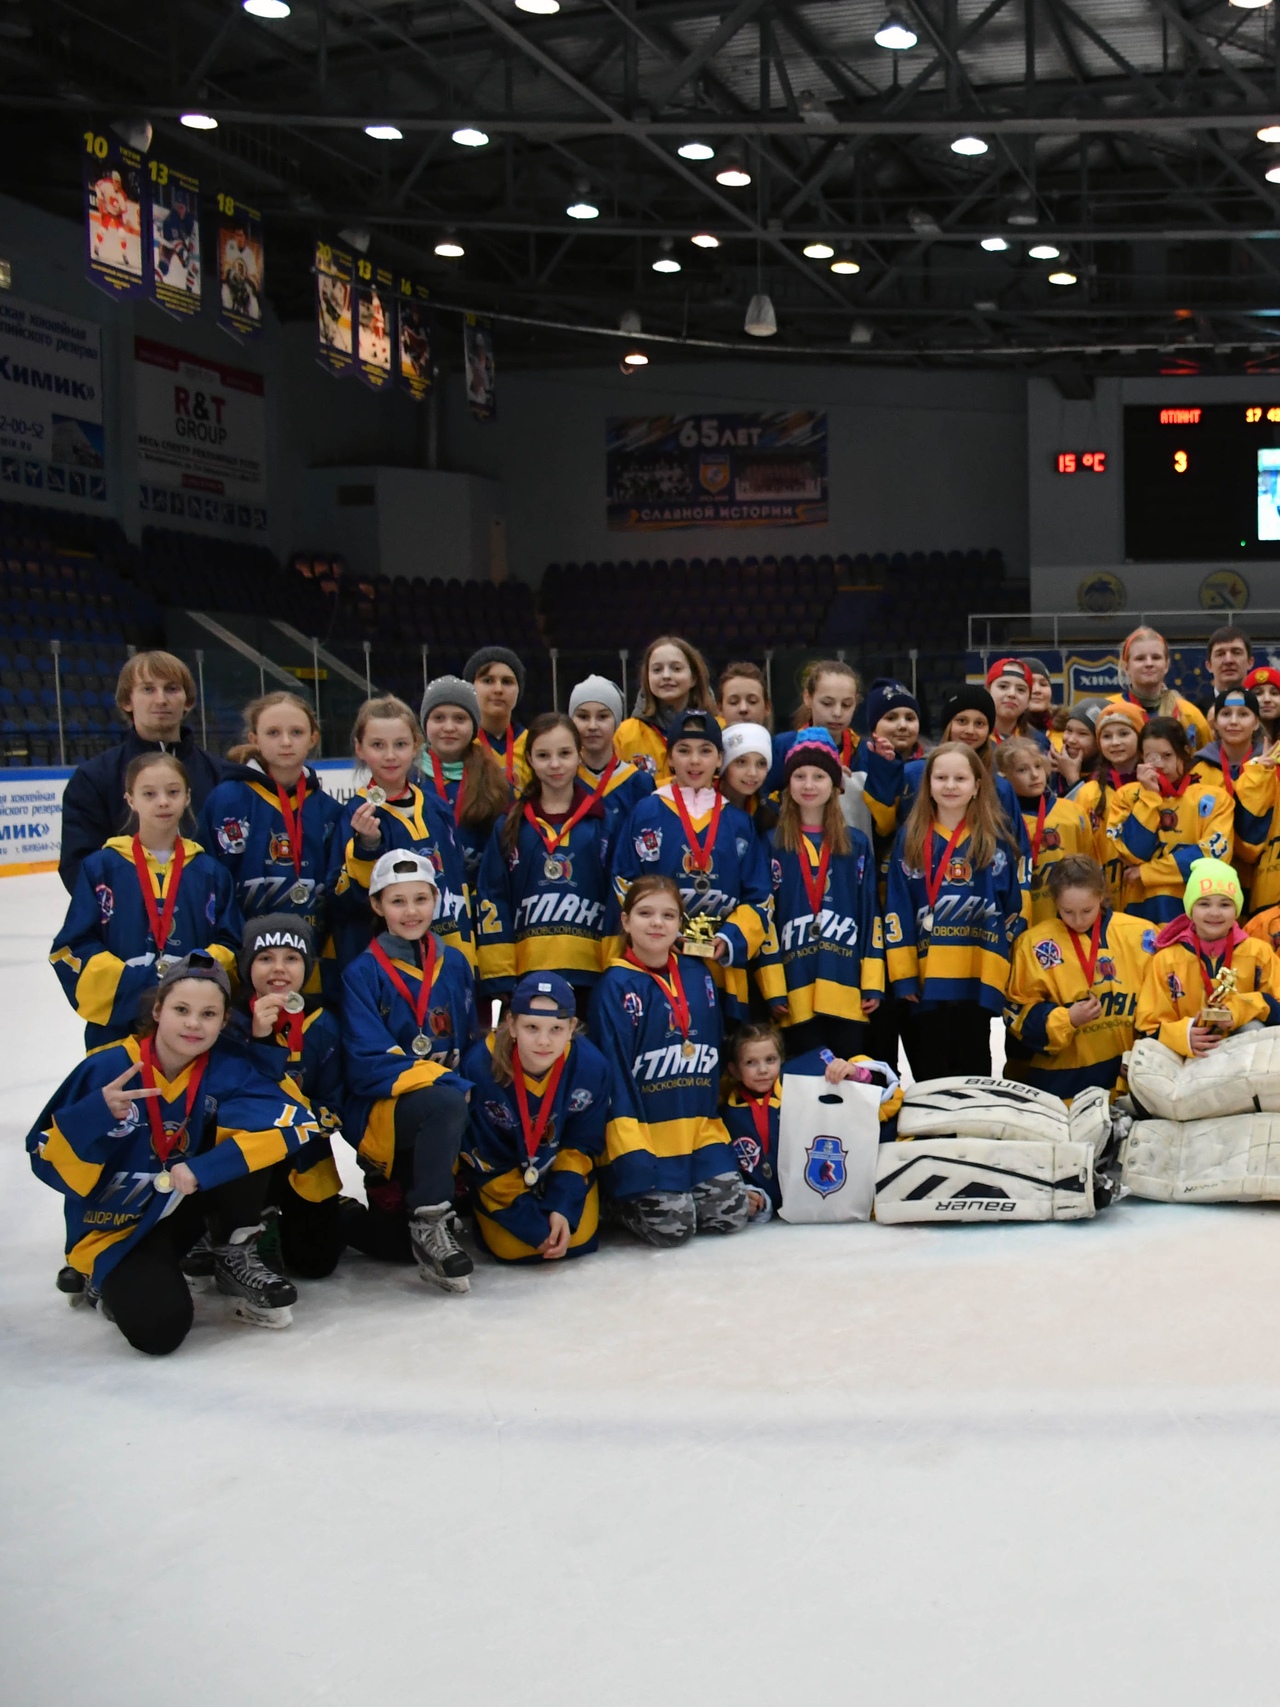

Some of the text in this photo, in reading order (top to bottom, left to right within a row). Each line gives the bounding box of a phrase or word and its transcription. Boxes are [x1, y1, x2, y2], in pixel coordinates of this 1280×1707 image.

[84, 131, 109, 159] 10
[149, 160, 169, 186] 13
[217, 193, 235, 217] 18
[174, 387, 226, 426] R&T
[175, 417, 227, 445] GROUP
[679, 419, 762, 448] 65 ЛЕТ
[1058, 453, 1077, 473] 15
[1174, 450, 1188, 473] 3
[640, 504, 793, 521] СЛАВНОЙ ИСТОРИИ
[254, 931, 308, 955] AMAIA
